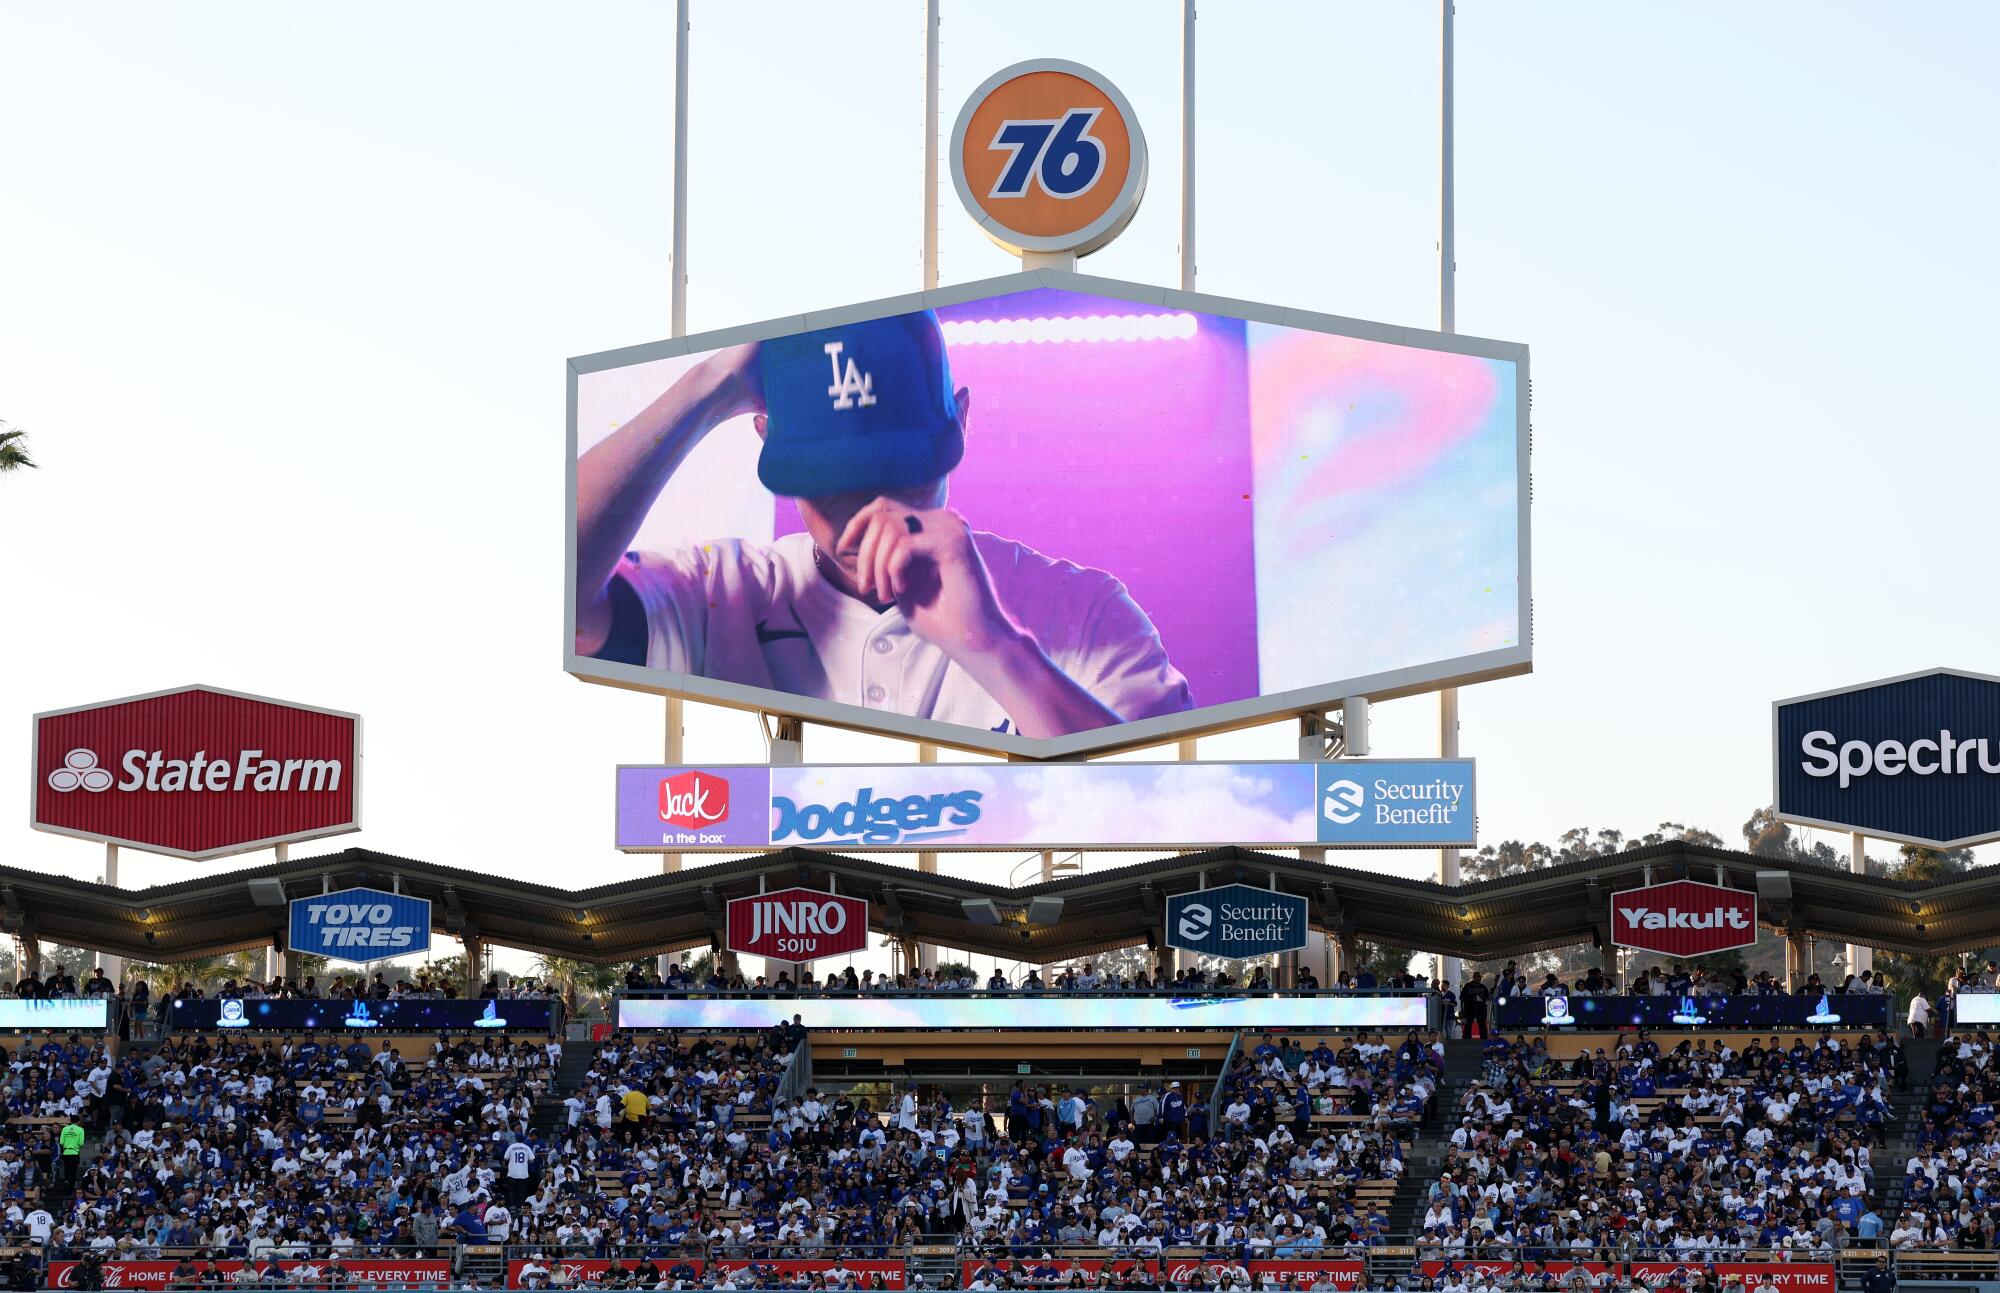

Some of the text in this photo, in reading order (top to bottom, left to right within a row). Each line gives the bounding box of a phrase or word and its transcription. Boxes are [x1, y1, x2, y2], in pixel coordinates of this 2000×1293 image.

[988, 108, 1106, 199] 76
[824, 341, 877, 410] LA
[117, 749, 342, 792] State Farm
[661, 778, 726, 820] Jack
[1374, 779, 1464, 804] Security
[772, 787, 983, 844] Dodgers
[1374, 804, 1452, 824] Benefit
[676, 833, 696, 844] the
[699, 833, 723, 844] box
[307, 904, 393, 924] TOYO
[748, 901, 847, 944] JINRO
[1221, 903, 1294, 924] Security
[1618, 907, 1750, 930] Yakult
[320, 927, 414, 946] TIRES
[1221, 923, 1284, 941] Benefit
[777, 938, 816, 953] SOJU
[515, 1152, 525, 1163] 18
[37, 1216, 46, 1225] 18
[128, 1271, 166, 1281] HOME
[367, 1270, 412, 1281] EVERY
[413, 1270, 447, 1281] TIME
[868, 1270, 901, 1281] TME
[1328, 1271, 1360, 1281] TIME
[1745, 1273, 1791, 1284] EVRY
[1793, 1273, 1828, 1284] TIME
